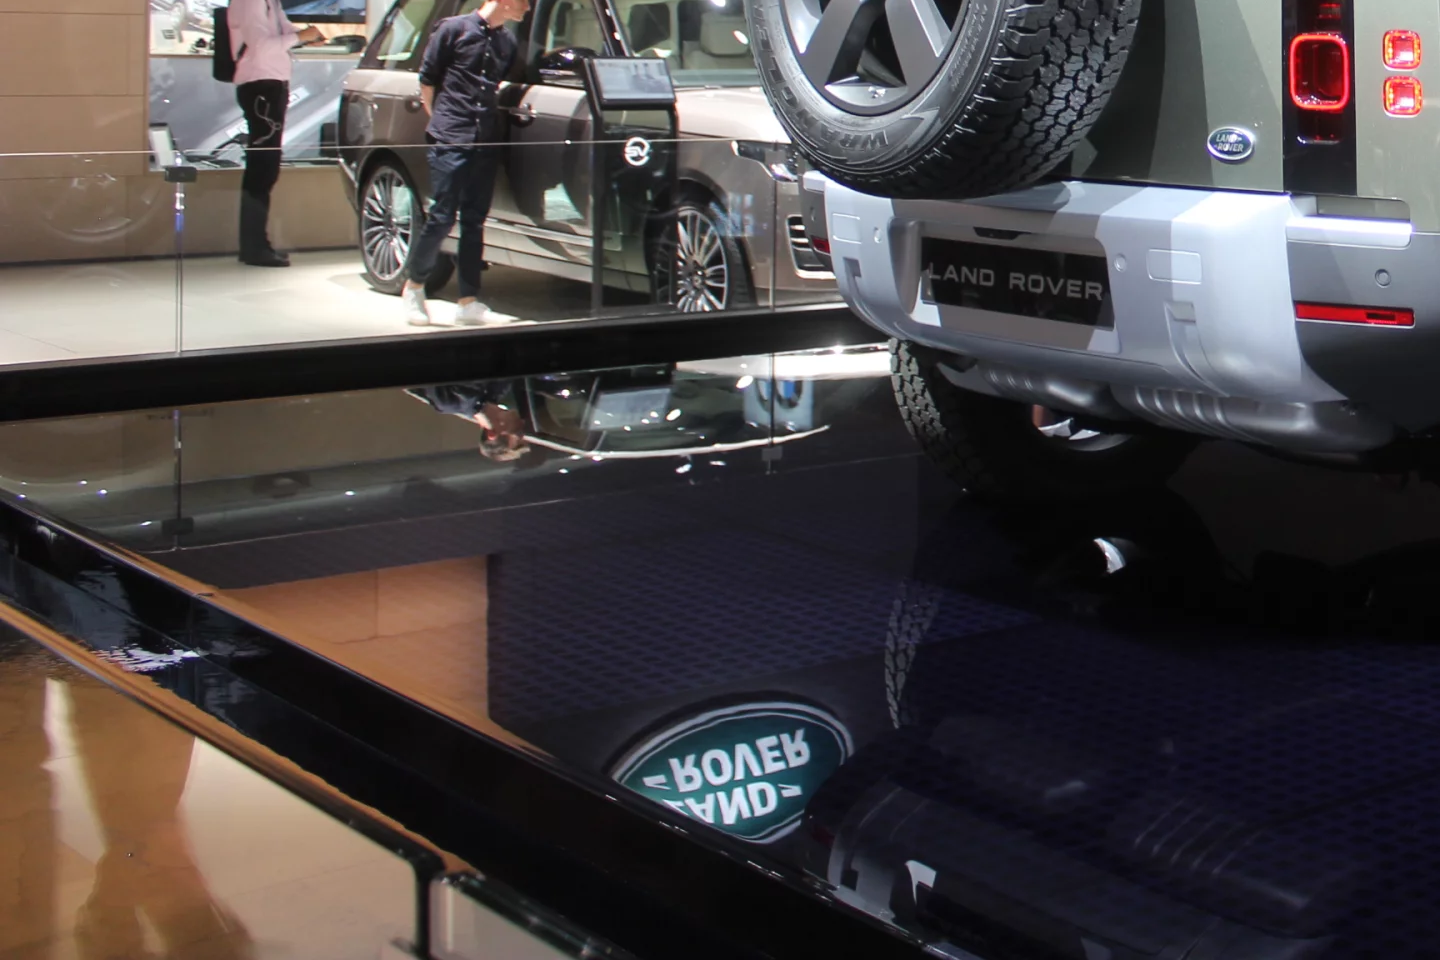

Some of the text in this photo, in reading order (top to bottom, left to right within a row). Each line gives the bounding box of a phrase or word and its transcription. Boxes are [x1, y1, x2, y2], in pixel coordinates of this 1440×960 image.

[1216, 133, 1238, 143] LAND
[1217, 142, 1244, 152] ROVER
[929, 262, 1103, 301] LAND ROVER
